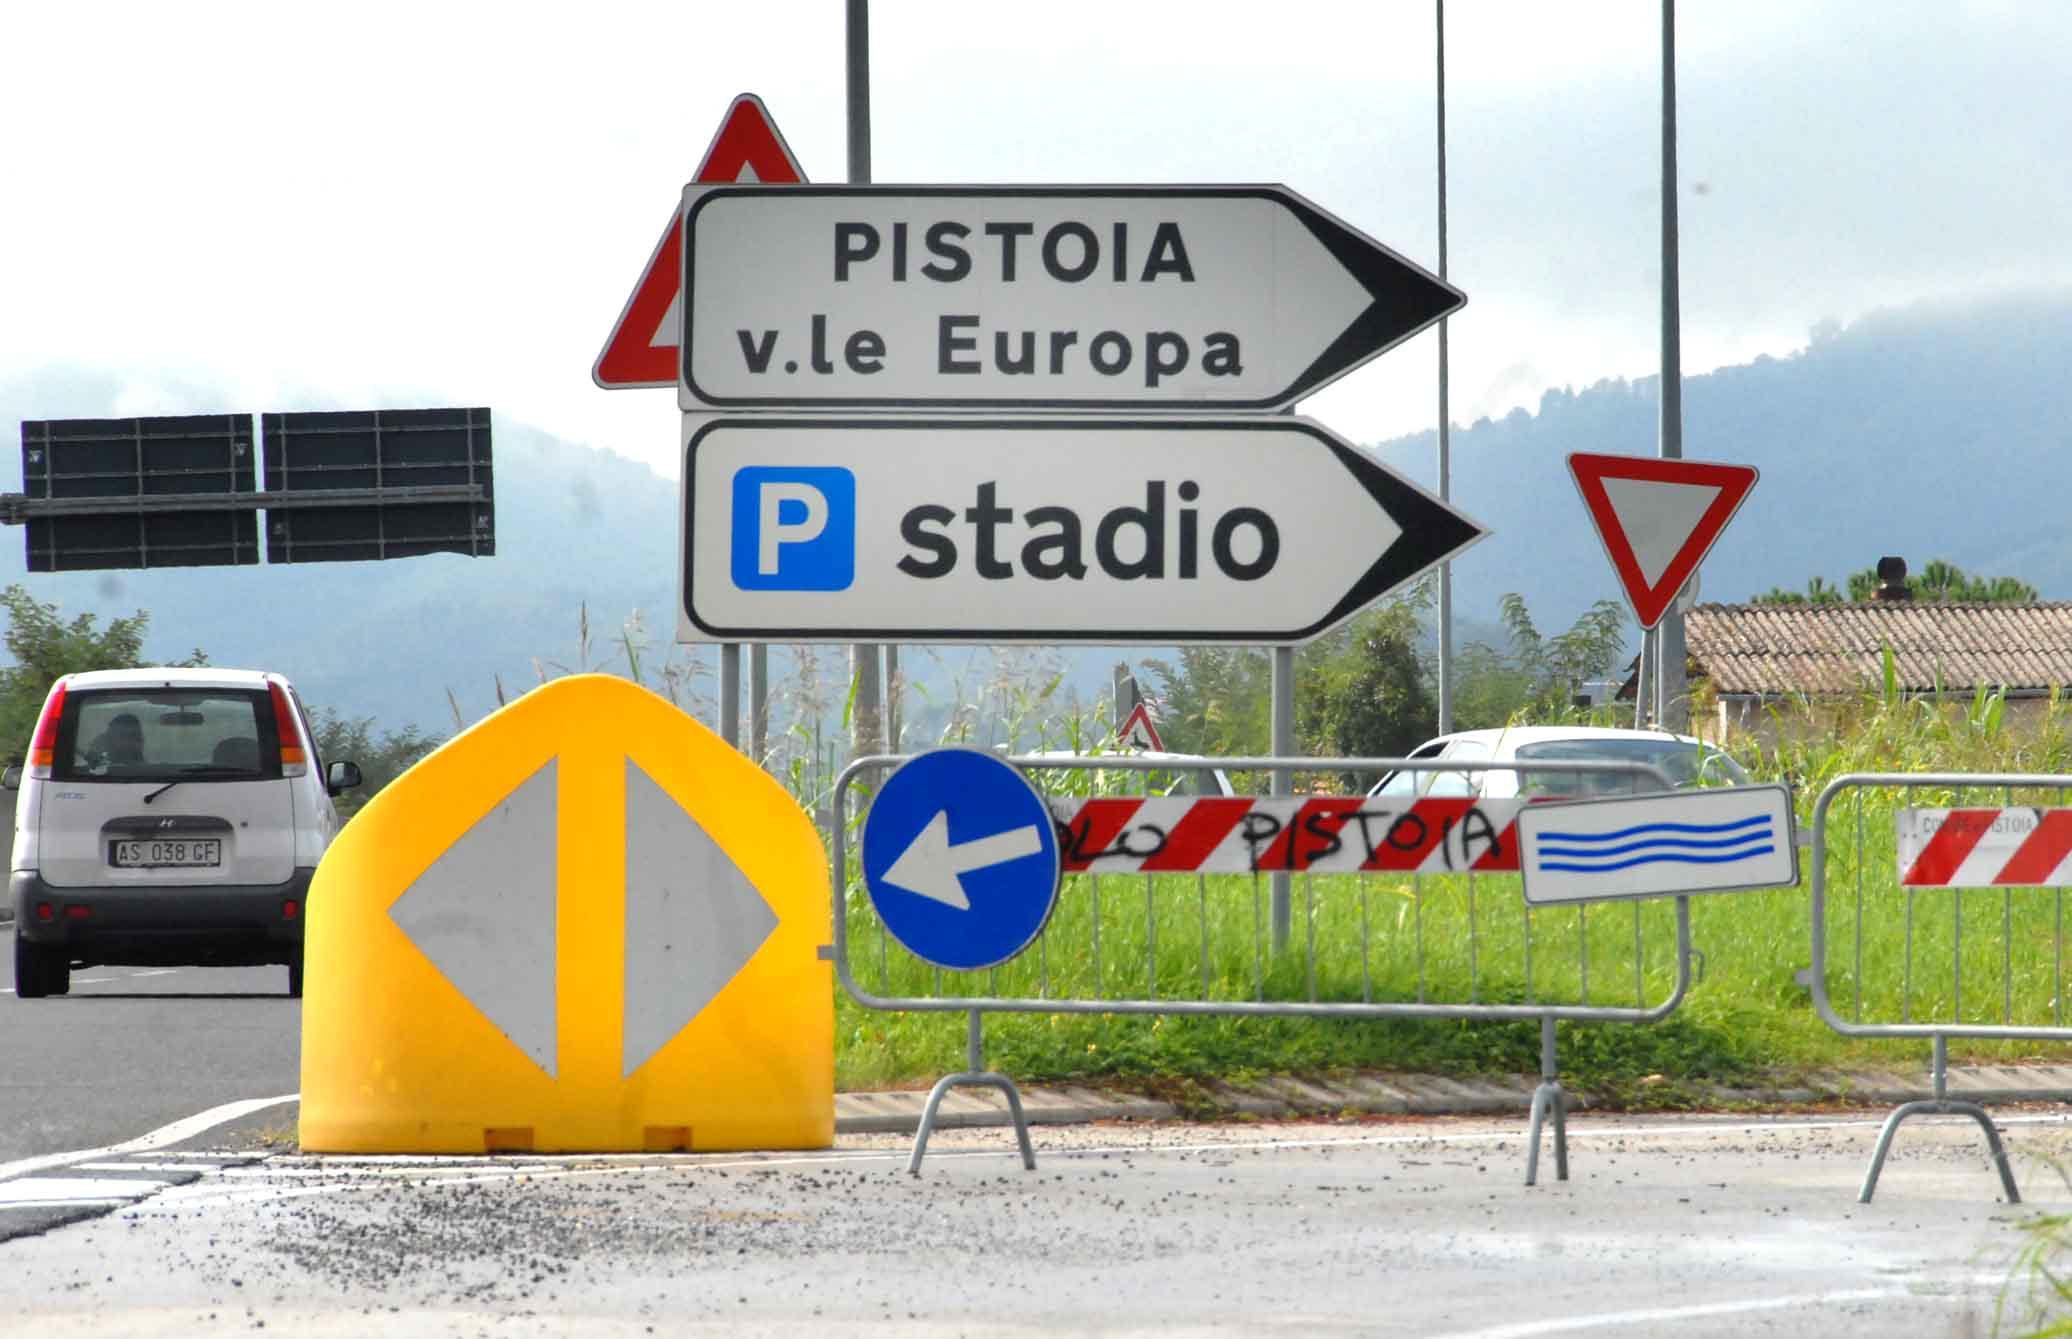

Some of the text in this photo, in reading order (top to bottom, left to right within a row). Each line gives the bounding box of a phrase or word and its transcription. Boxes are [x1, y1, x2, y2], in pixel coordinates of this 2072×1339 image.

[834, 221, 1195, 283] PISTOIA
[737, 314, 1243, 388] v.le Europa
[757, 480, 1280, 582] P stadio
[119, 842, 142, 861] AS
[151, 842, 185, 861] 038
[1241, 807, 1502, 872] PISTOIA
